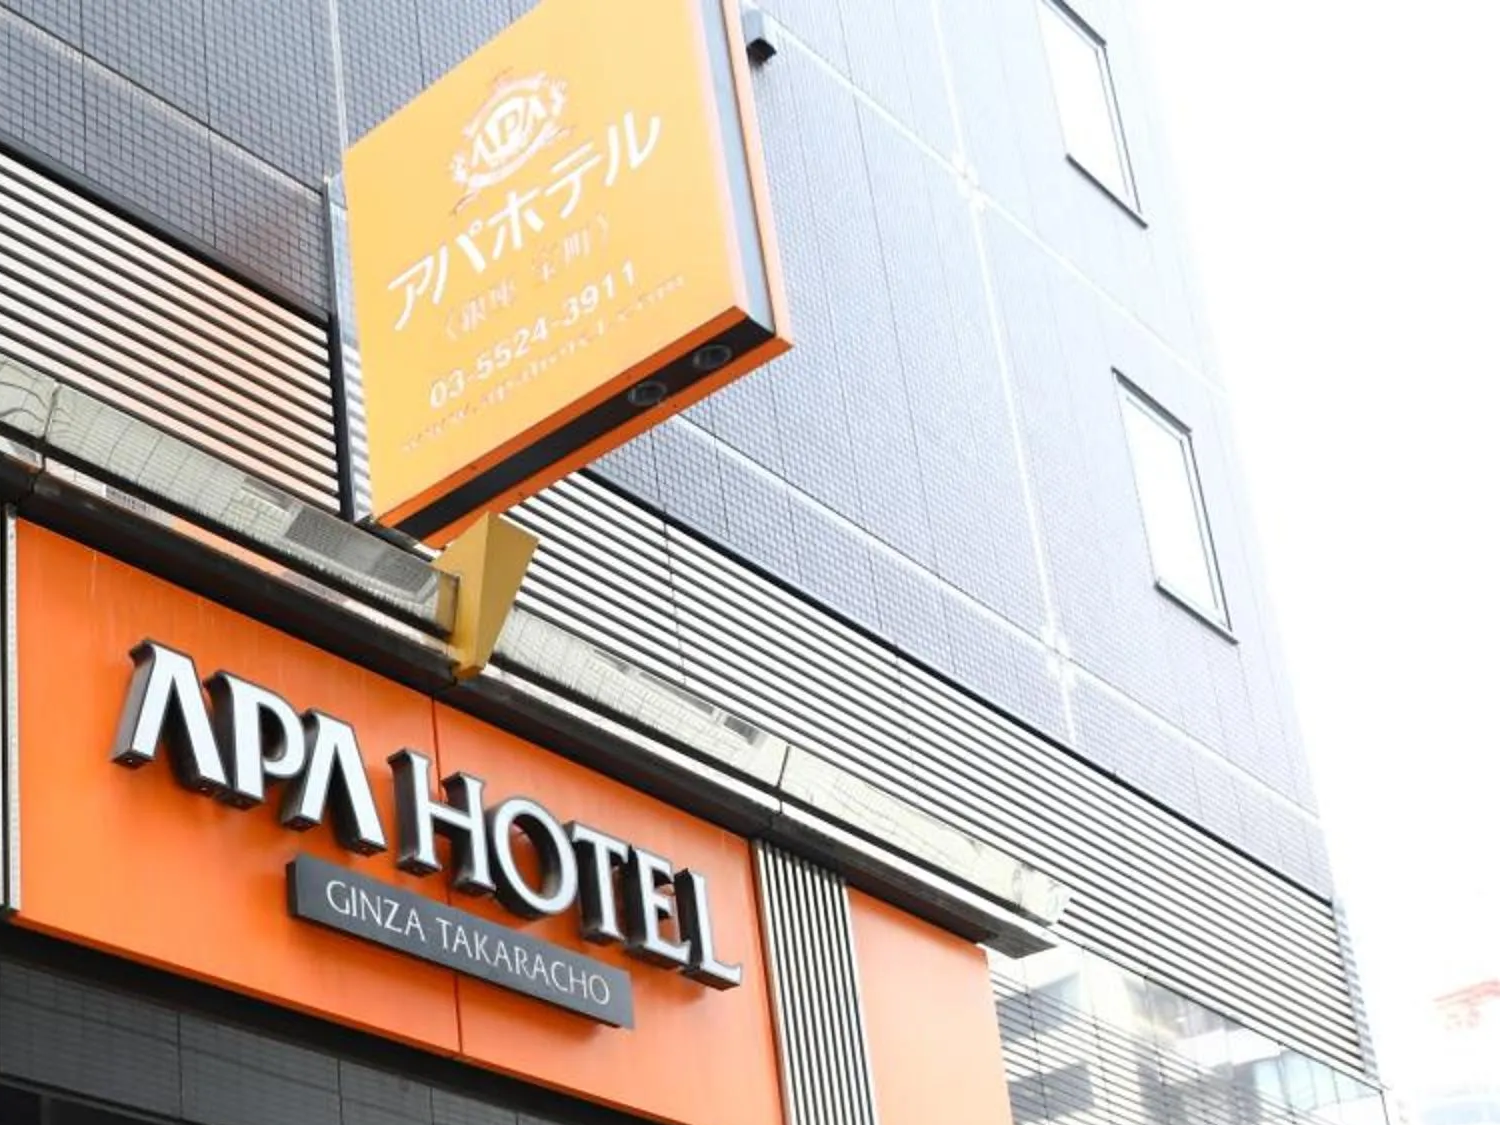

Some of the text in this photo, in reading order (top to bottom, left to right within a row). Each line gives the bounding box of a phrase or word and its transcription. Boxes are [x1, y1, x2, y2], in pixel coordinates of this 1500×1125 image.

[387, 110, 661, 331] アパホテル
[429, 260, 637, 408] 03-5524-3911
[113, 638, 742, 990] APA HOTEL
[326, 879, 611, 1006] GINZA TAKARACHO
